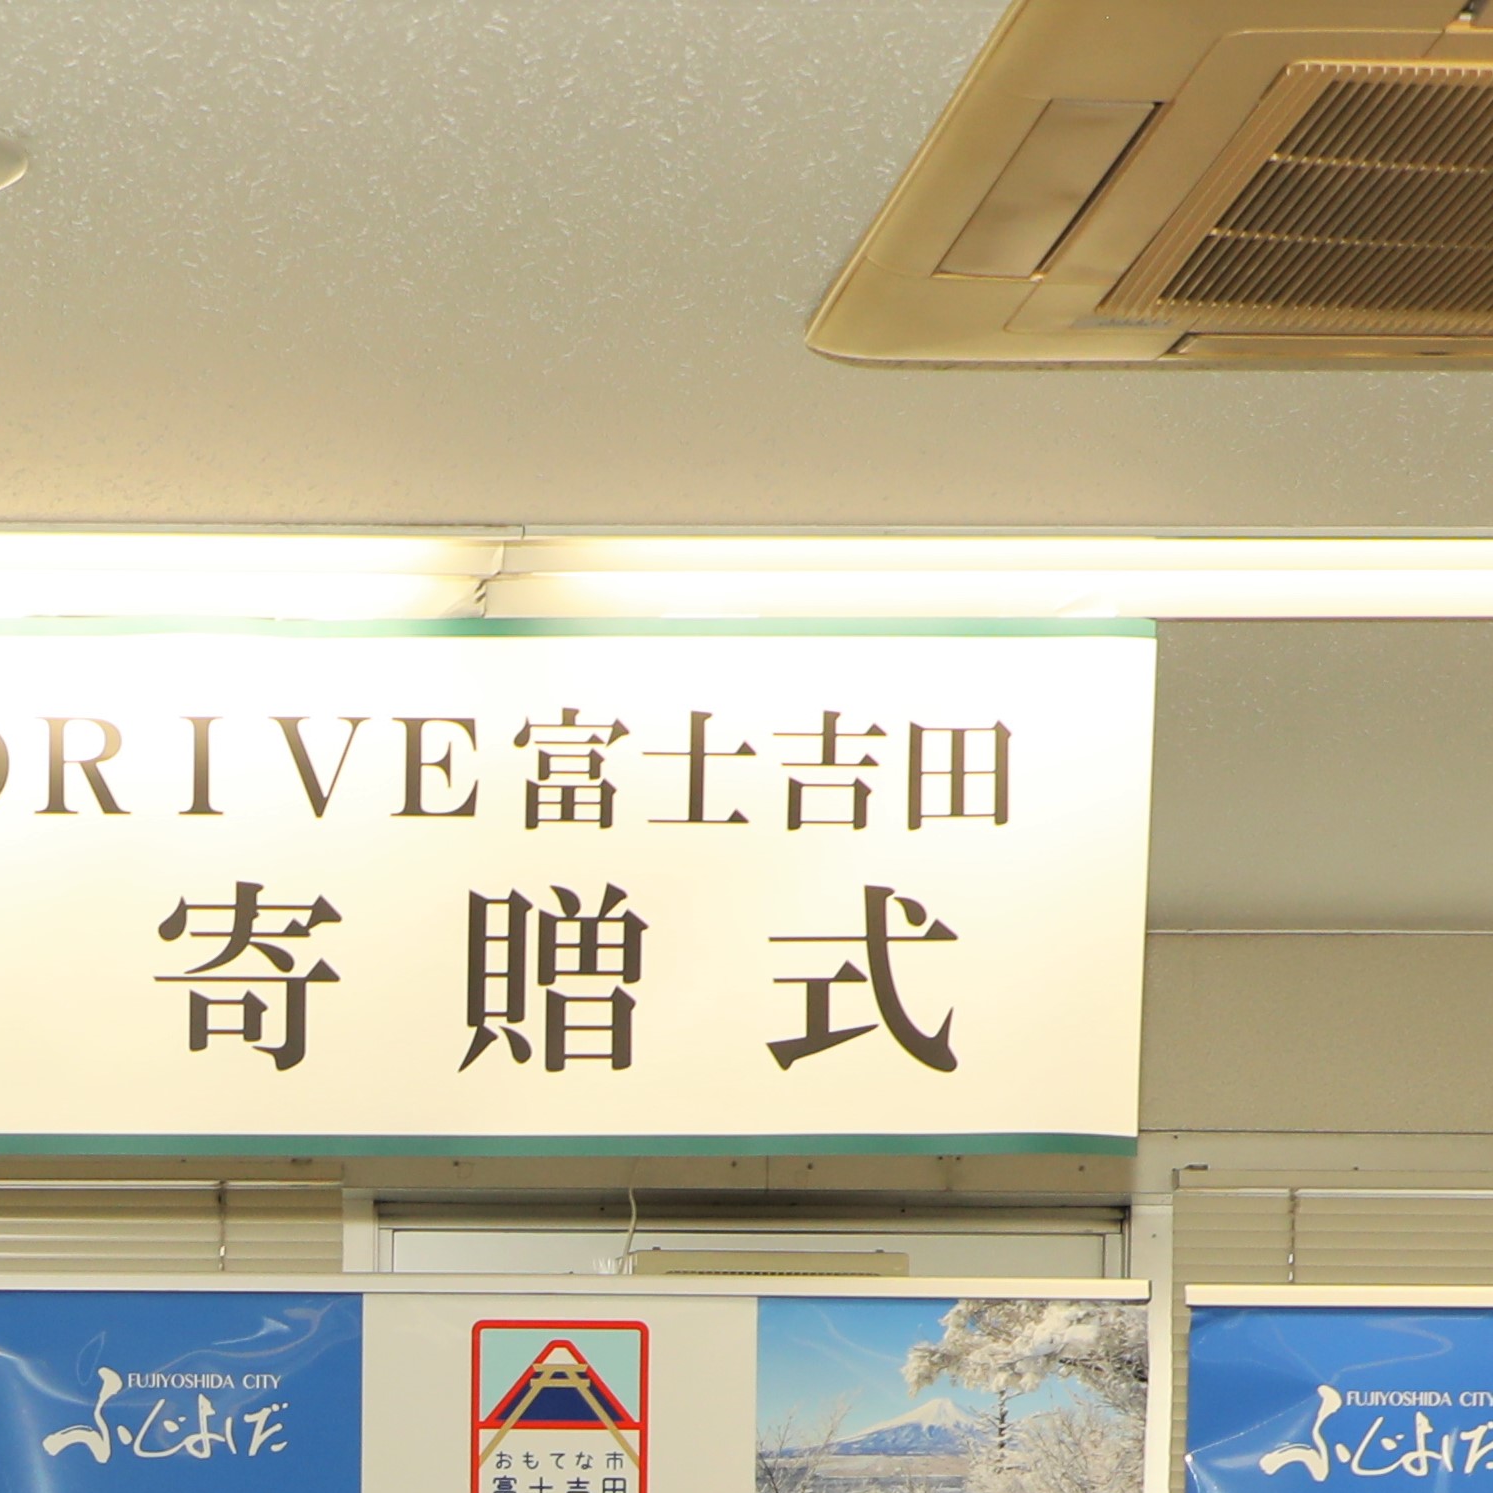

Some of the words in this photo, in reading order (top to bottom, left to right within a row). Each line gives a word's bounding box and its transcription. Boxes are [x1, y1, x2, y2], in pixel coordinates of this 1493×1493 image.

[127, 1372, 235, 1390] FUJIYOSHIDA
[242, 1373, 282, 1390] CITY
[1346, 1390, 1453, 1407] FUJIYOSHIDA
[495, 1450, 625, 1471] おもてな市
